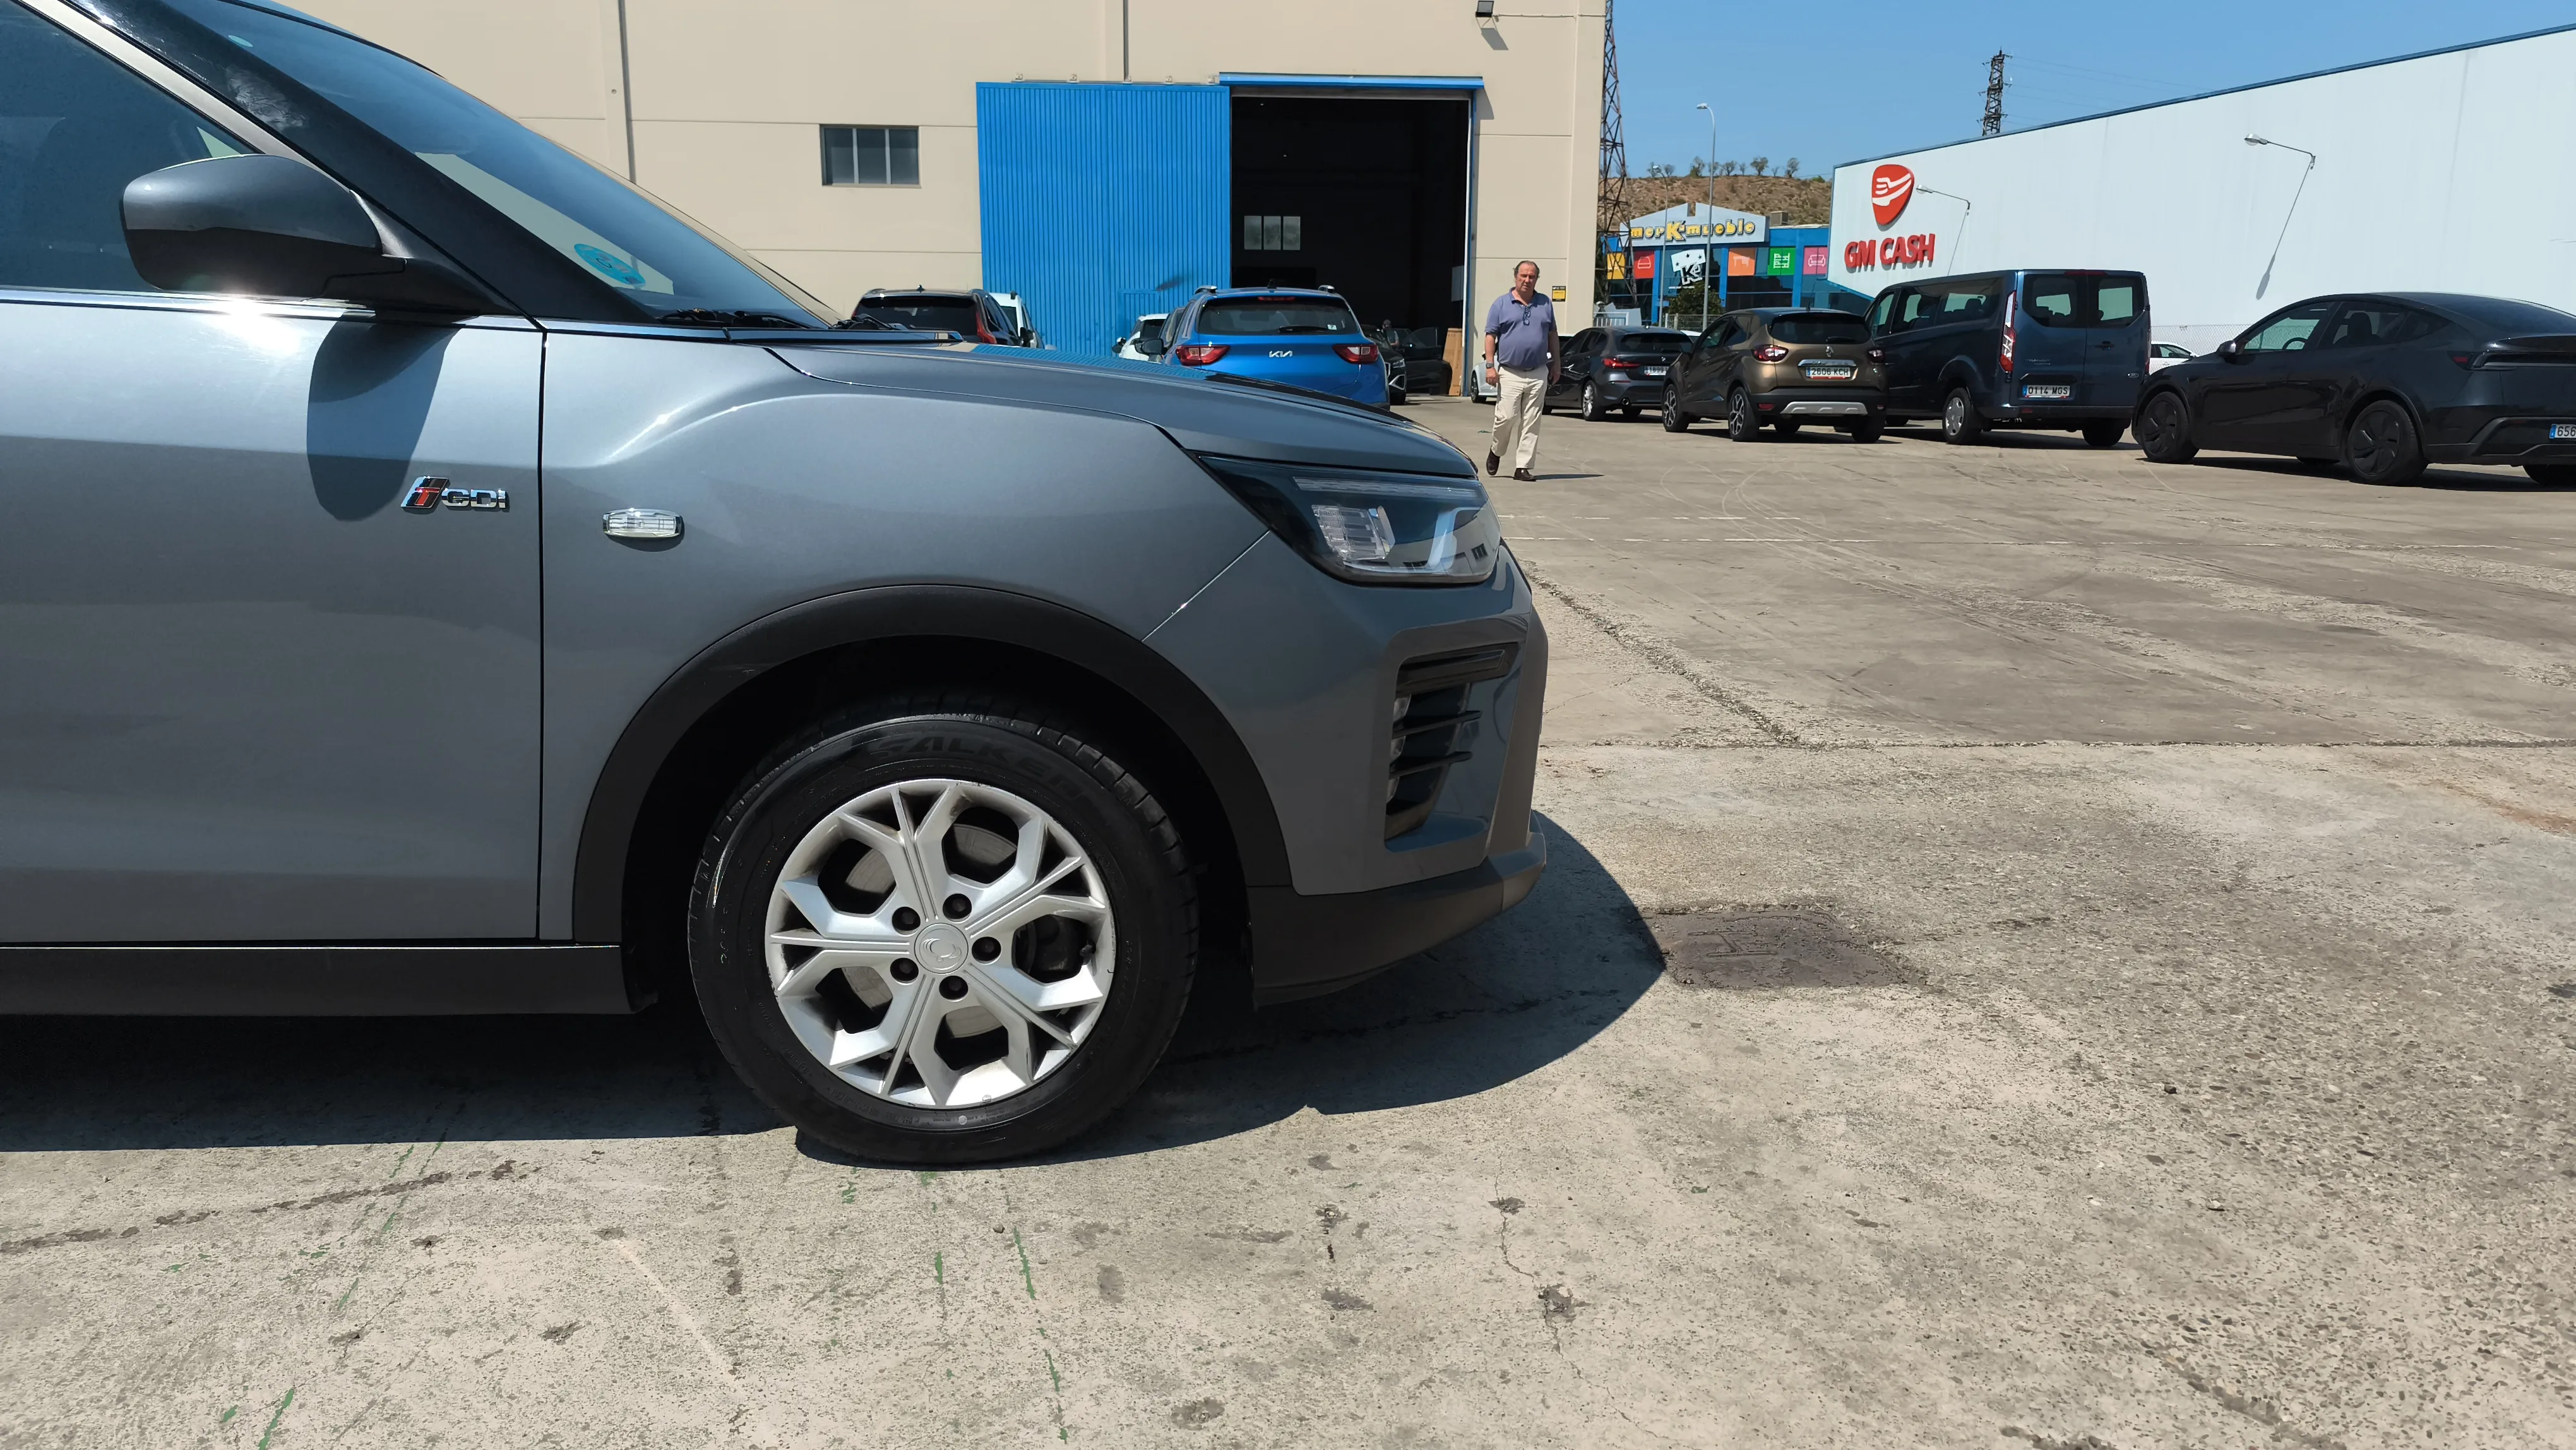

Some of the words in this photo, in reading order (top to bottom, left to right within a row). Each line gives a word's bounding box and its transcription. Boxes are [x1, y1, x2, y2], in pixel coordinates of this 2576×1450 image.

[1844, 239, 1876, 268] GM
[1880, 233, 1935, 264] CASH
[2557, 426, 2576, 436] 656
